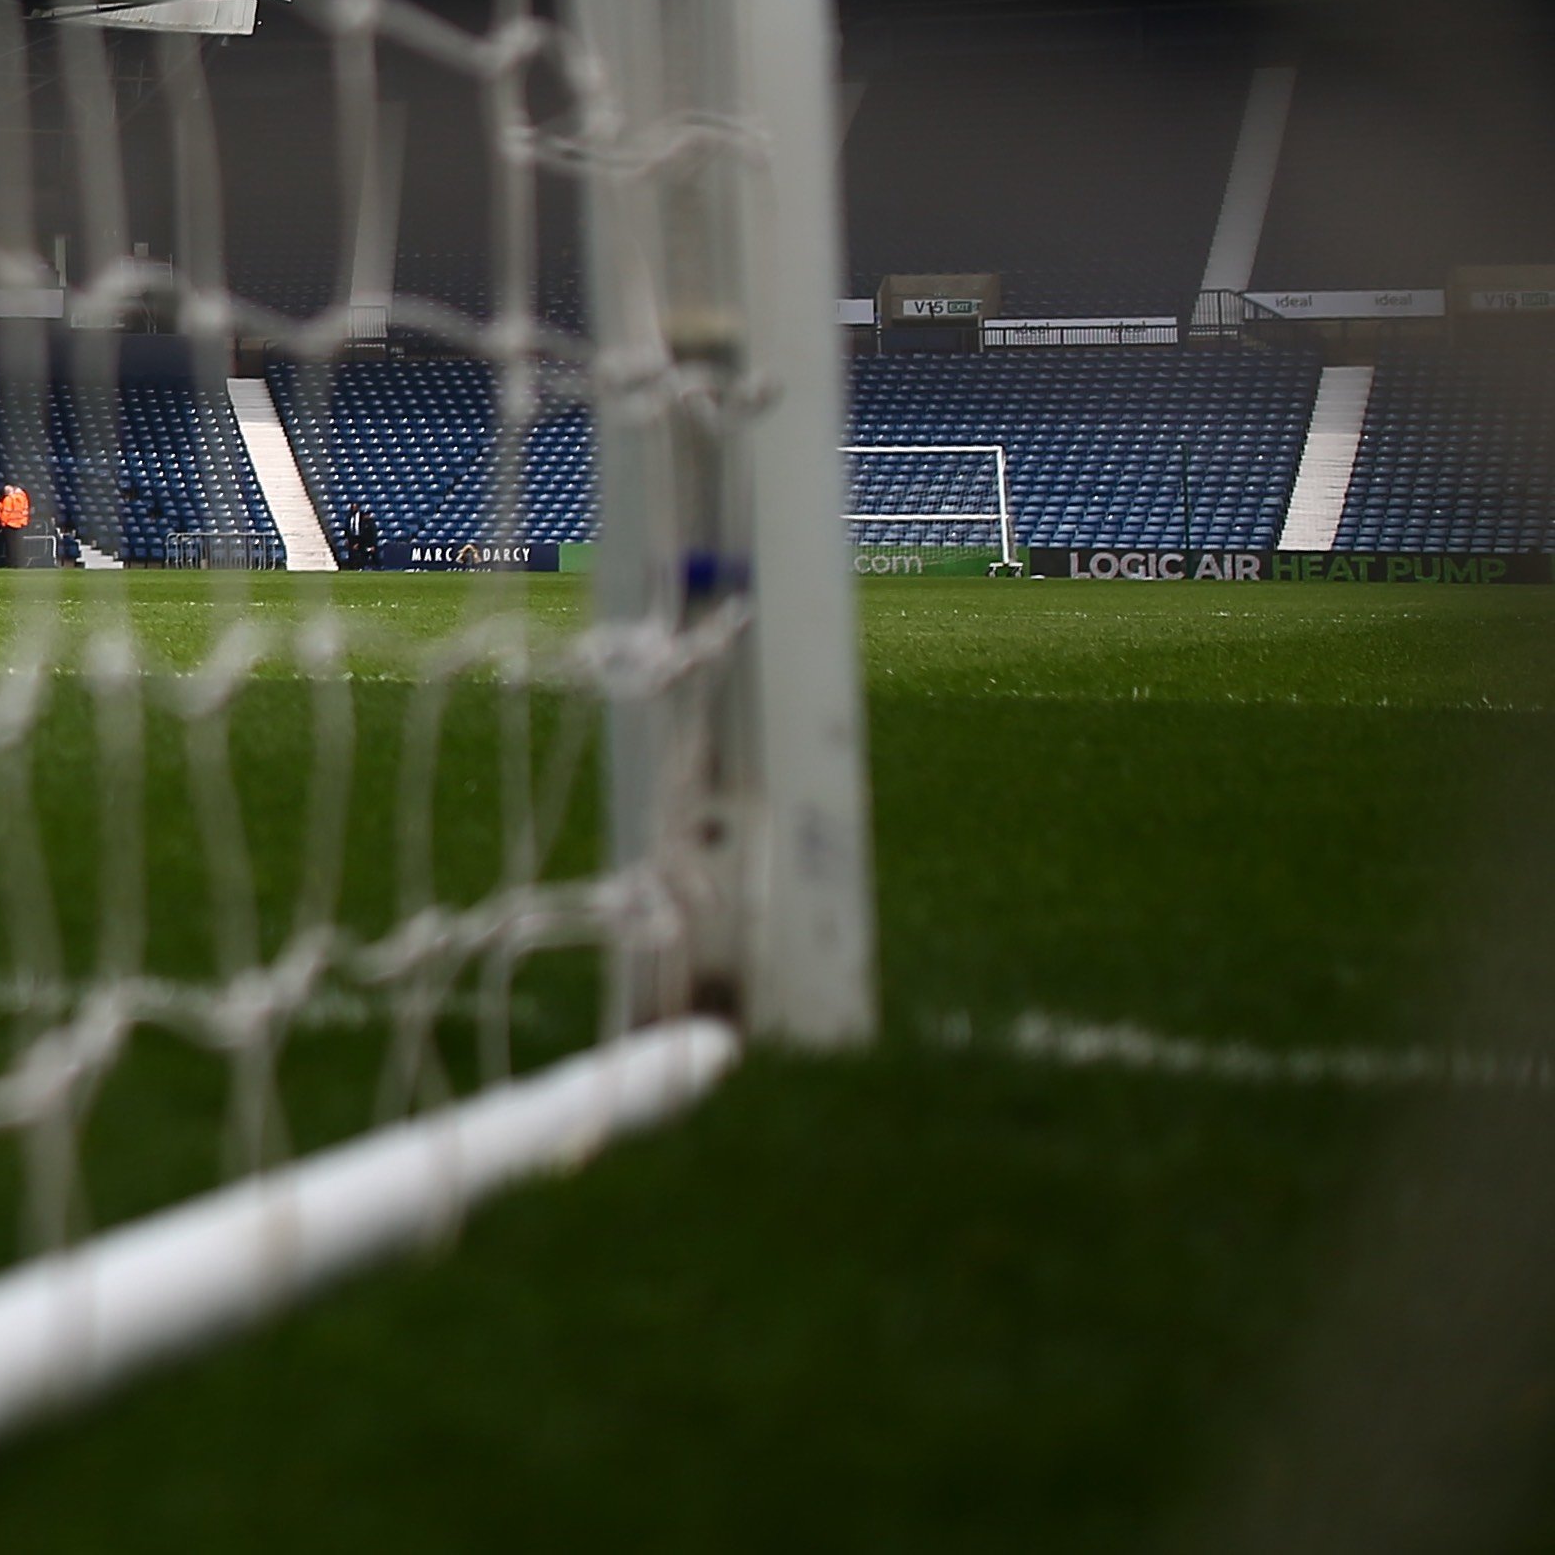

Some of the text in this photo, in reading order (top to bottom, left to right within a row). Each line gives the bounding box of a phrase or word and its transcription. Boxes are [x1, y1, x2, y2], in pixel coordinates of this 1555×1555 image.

[914, 300, 943, 314] V15
[1276, 293, 1413, 309] ideal ideal
[411, 547, 531, 562] MARC DARCY
[1069, 551, 1508, 584] LOGIC AIR HEAT PUMP
